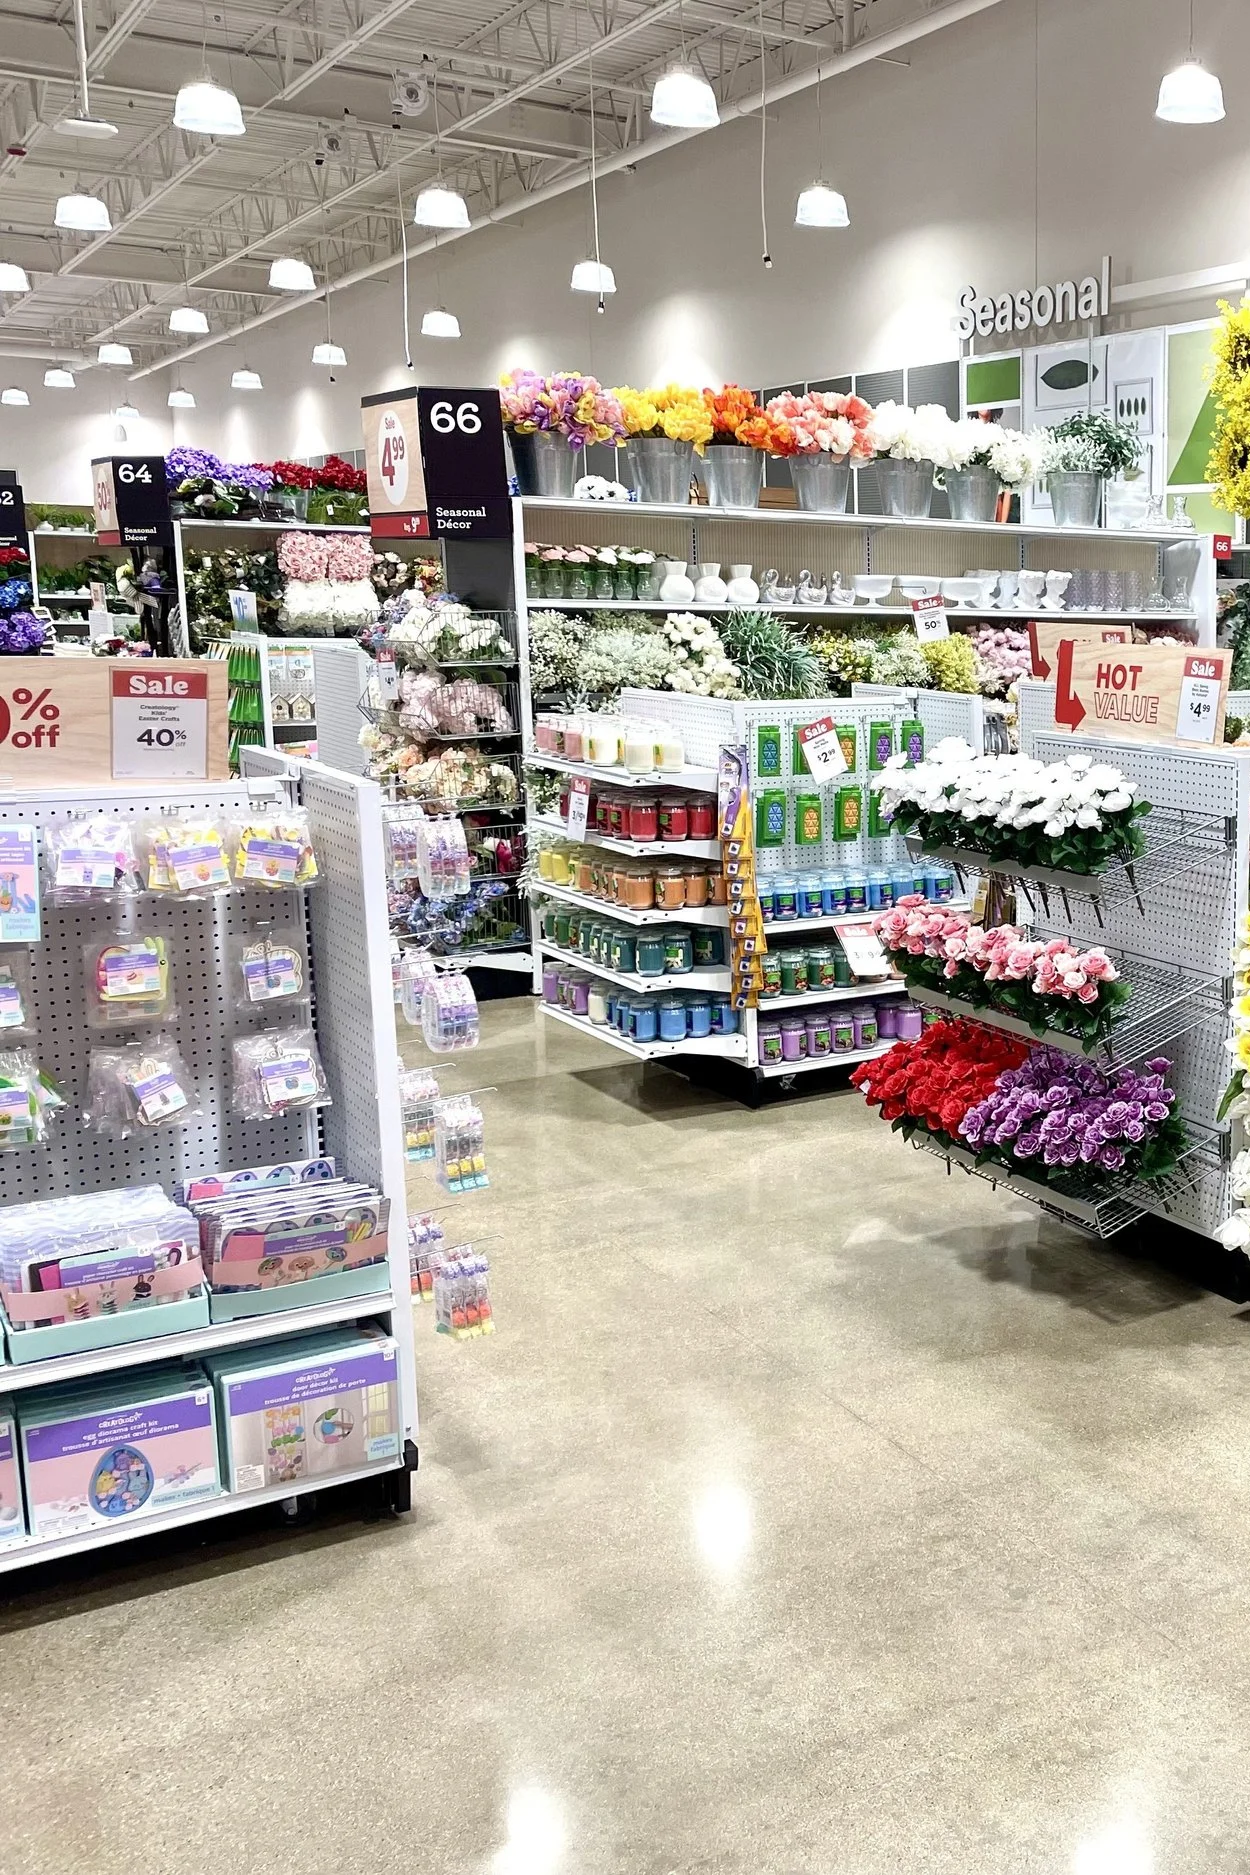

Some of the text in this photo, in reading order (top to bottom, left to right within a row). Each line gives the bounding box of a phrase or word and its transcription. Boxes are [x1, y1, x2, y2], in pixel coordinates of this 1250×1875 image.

[955, 256, 1112, 340] Seasonal
[430, 401, 482, 434] 66
[118, 463, 152, 483] 64
[436, 507, 486, 517] Seasonal
[437, 519, 472, 529] Décor
[1216, 541, 1228, 551] 66
[918, 599, 938, 609] Sale
[1096, 663, 1142, 690] HOT
[1190, 660, 1215, 677] Sale
[129, 675, 188, 696] Sale
[1094, 692, 1160, 725] VALUE
[11, 724, 60, 749] off
[136, 728, 187, 747] 40%
[804, 723, 828, 740] Sale
[264, 1396, 289, 1405] trousse
[291, 1392, 300, 1400] de
[300, 1384, 337, 1398] décoration
[348, 1378, 366, 1388] porte
[292, 1377, 339, 1392] door décor kit
[62, 1441, 90, 1452] trousse
[149, 1423, 179, 1434] diorama
[82, 1433, 96, 1441] egg
[97, 1425, 129, 1438] diorama
[130, 1422, 147, 1432] craft
